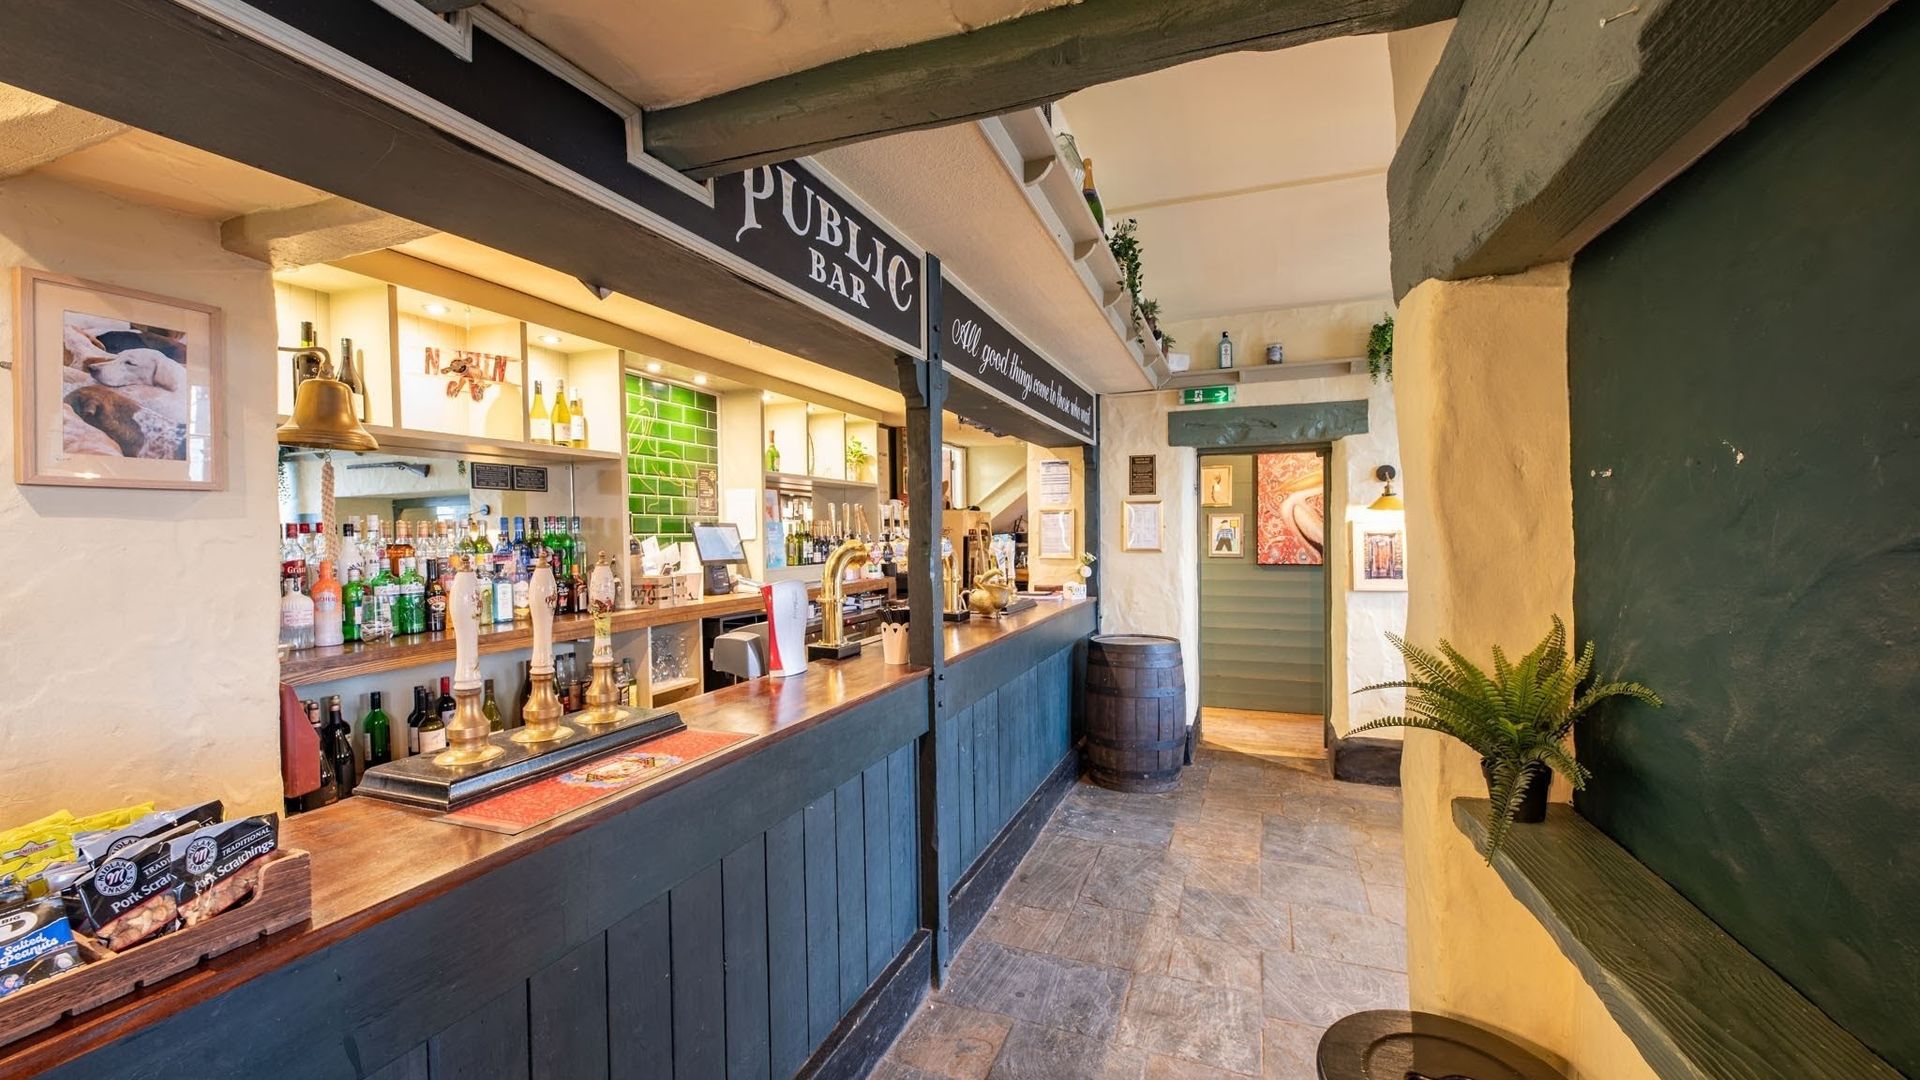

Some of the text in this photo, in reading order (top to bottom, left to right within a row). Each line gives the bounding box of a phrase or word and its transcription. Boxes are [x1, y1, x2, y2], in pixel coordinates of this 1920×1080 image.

[736, 164, 914, 312] PUBLIC
[808, 246, 870, 309] BAR
[951, 318, 982, 357] All
[978, 344, 1011, 375] good
[1008, 351, 1034, 401] things
[1032, 378, 1050, 402] come
[1049, 379, 1057, 406] to
[188, 840, 216, 859] MIDLAND
[222, 826, 271, 857] TRADITIONAL
[97, 861, 134, 882] MIDLAND
[188, 855, 214, 872] SNACKS
[194, 838, 275, 893] Pork Scratchings
[101, 876, 134, 894] SNACKS
[110, 891, 143, 914] Pork
[0, 937, 59, 969] Peanuts
[3, 932, 48, 956] Salted
